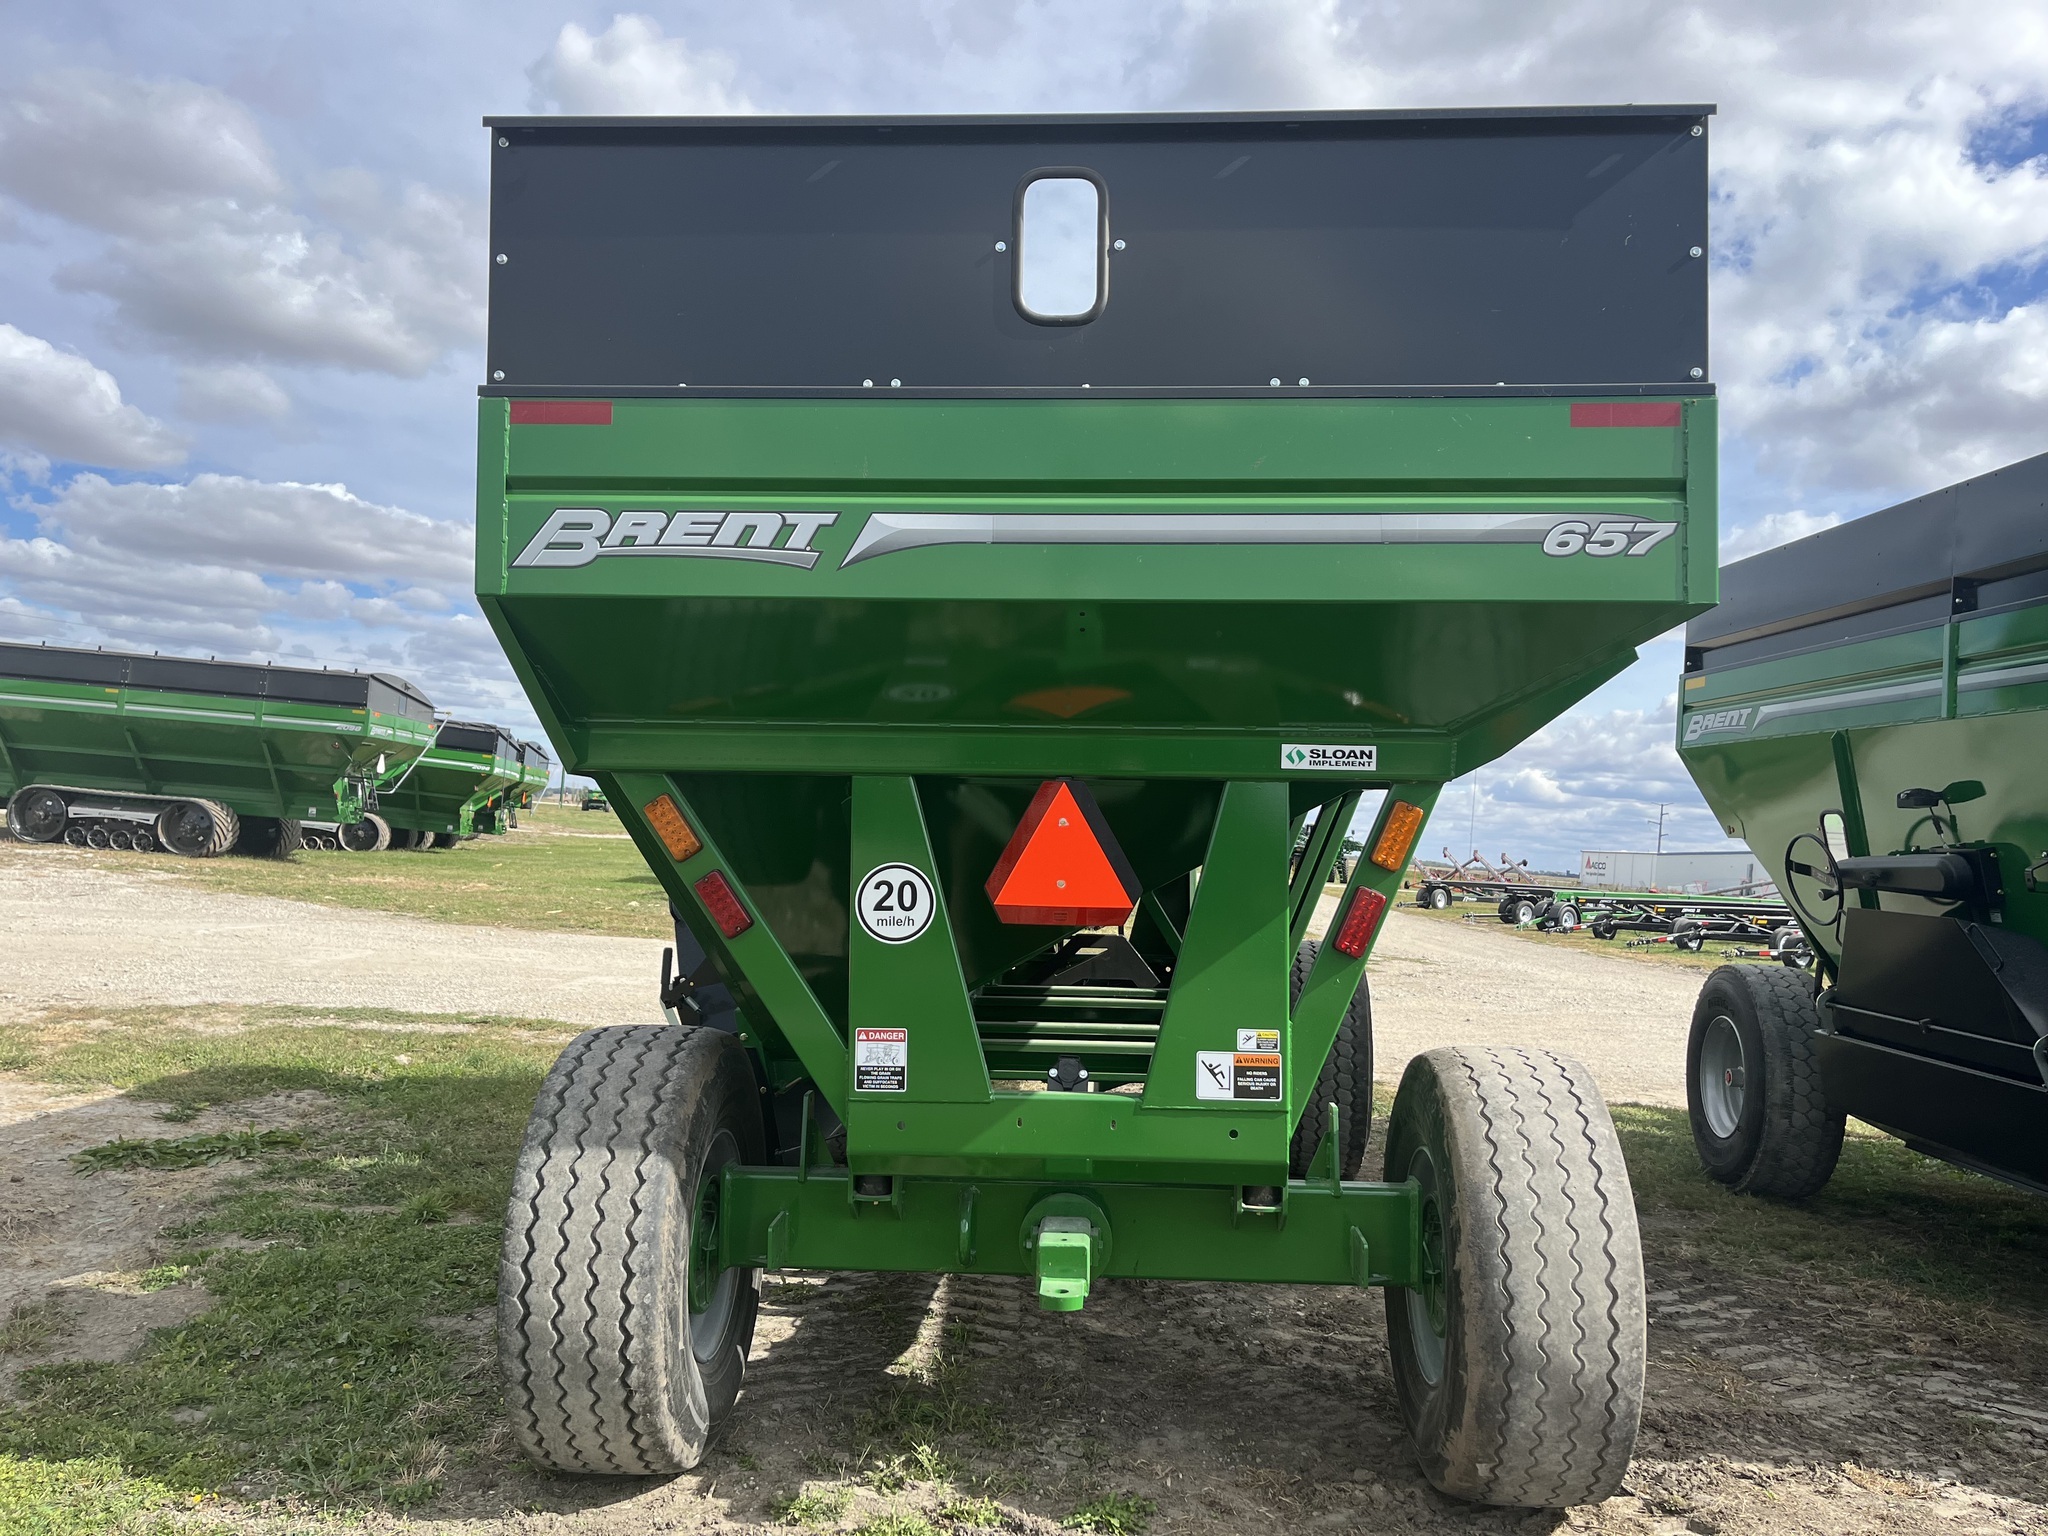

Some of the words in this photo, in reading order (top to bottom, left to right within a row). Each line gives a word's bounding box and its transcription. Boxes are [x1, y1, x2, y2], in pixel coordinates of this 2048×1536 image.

[508, 508, 842, 570] BRENT
[1542, 520, 1680, 557] 657
[1683, 708, 1752, 741] BRENT
[1309, 749, 1373, 760] SLOAN
[873, 880, 917, 912] 20
[877, 916, 915, 926] mile/h
[869, 1032, 904, 1040] DANGER
